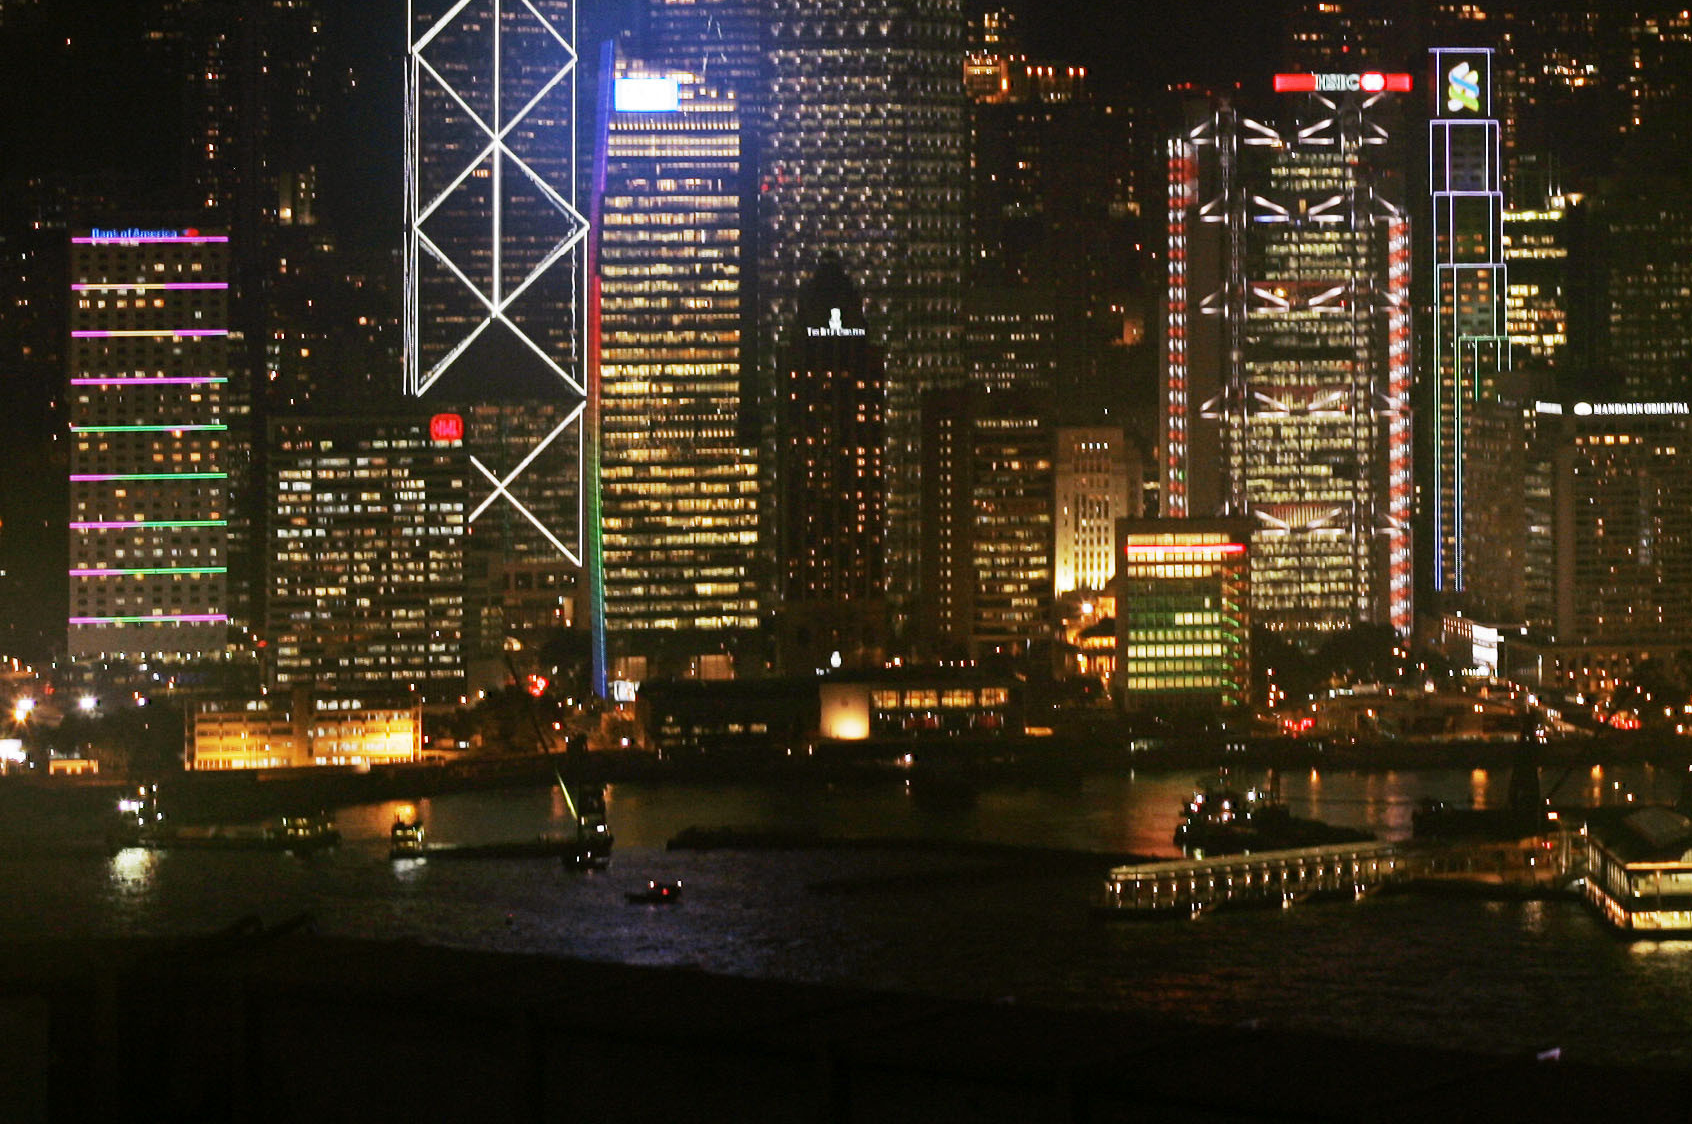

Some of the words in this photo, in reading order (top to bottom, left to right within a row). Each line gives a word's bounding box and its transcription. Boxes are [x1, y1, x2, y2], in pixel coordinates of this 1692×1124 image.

[91, 227, 118, 238] Bank
[132, 227, 178, 238] America
[1593, 402, 1644, 415] MANDARIN
[1644, 402, 1690, 415] ORIENTAL
